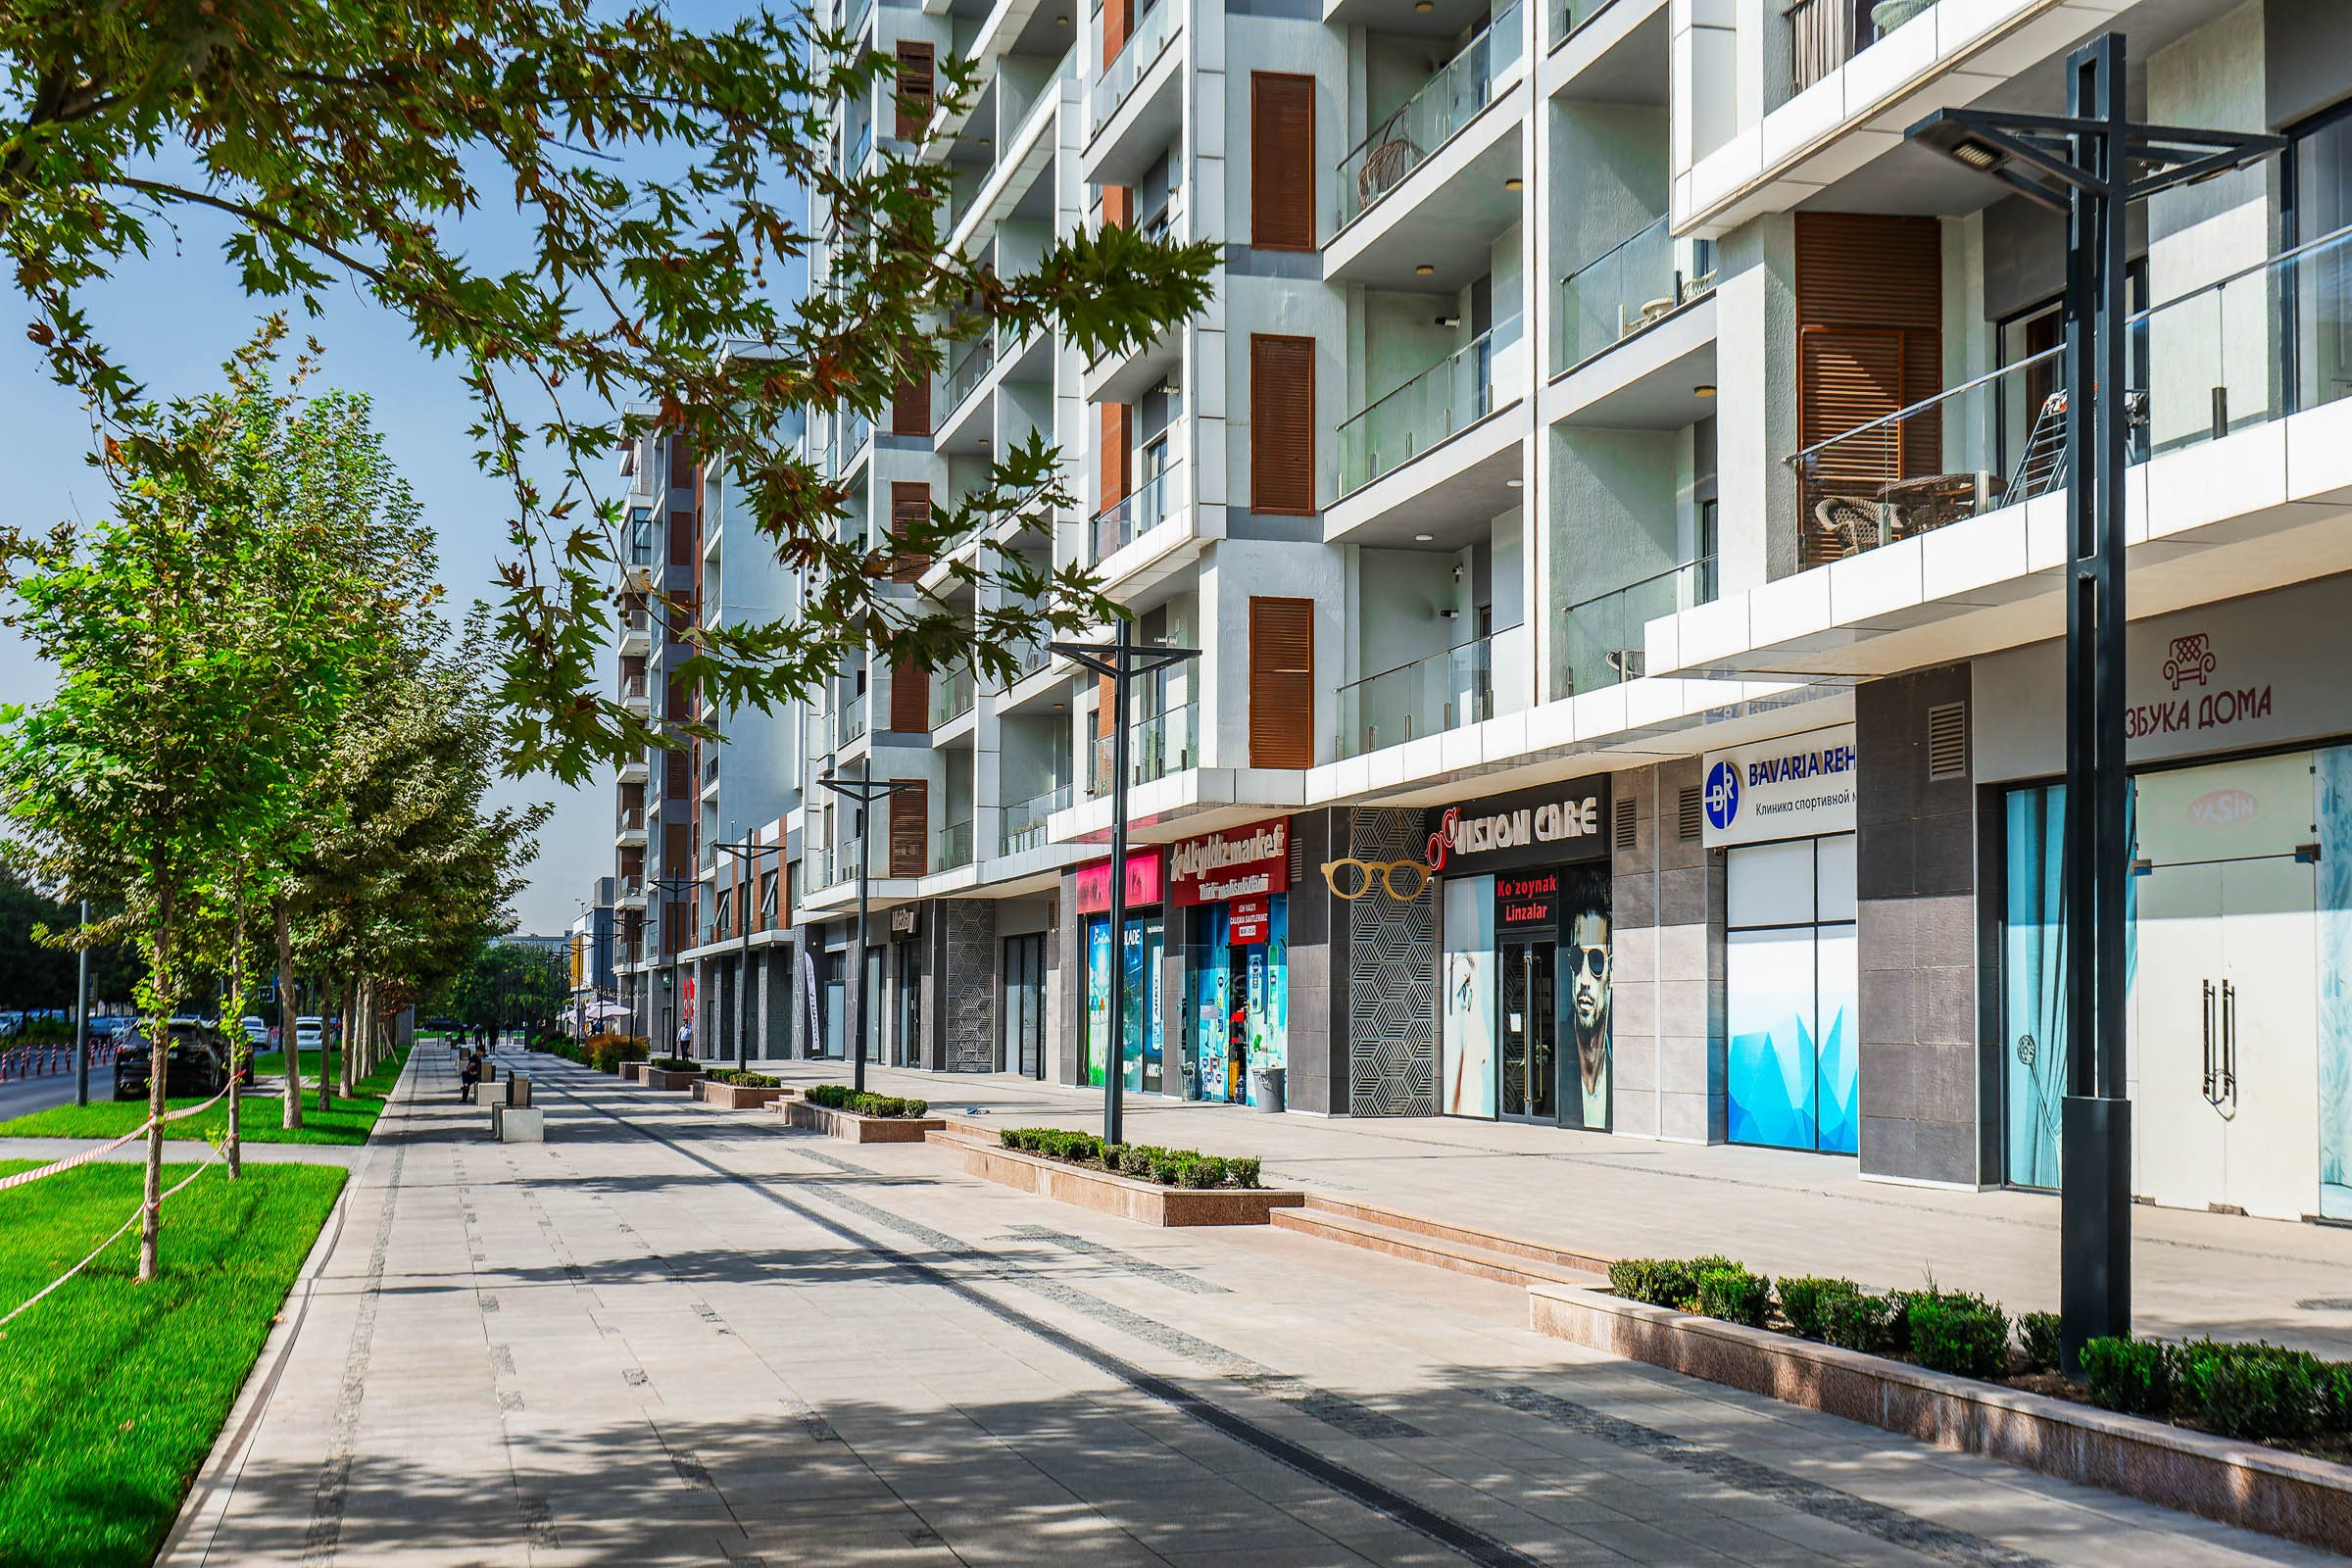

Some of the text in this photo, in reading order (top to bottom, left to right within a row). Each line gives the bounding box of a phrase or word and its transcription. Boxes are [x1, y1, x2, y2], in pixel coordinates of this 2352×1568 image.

[2198, 685, 2272, 730] ДОМА
[1749, 752, 1821, 787] BAVARIA
[1755, 802, 1793, 816] Клиника
[1794, 788, 1850, 811] спортивной
[1448, 797, 1597, 856] VISION CARE
[1505, 903, 1548, 922] Linzalar
